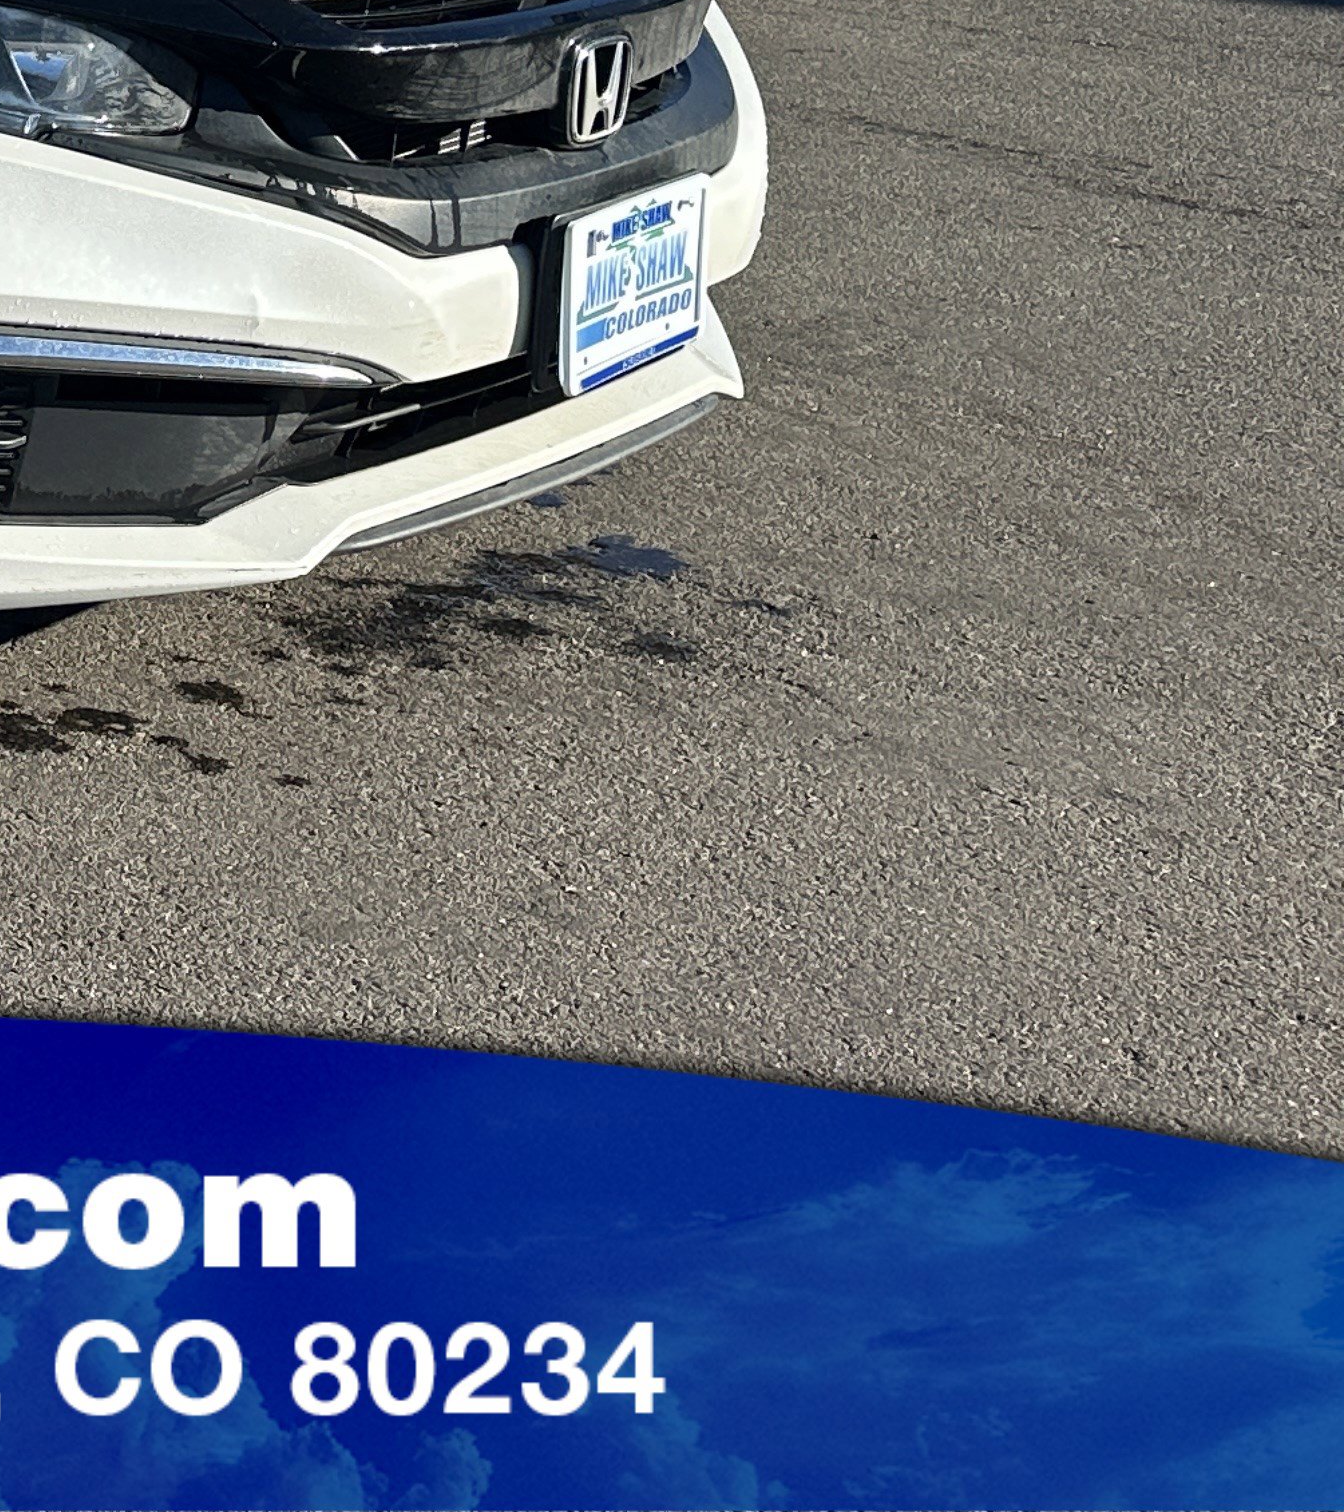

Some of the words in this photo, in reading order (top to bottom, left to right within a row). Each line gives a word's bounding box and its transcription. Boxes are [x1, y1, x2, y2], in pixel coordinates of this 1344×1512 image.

[584, 250, 628, 311] MIKE
[635, 229, 688, 292] SHAW
[605, 287, 692, 340] COLORADO
